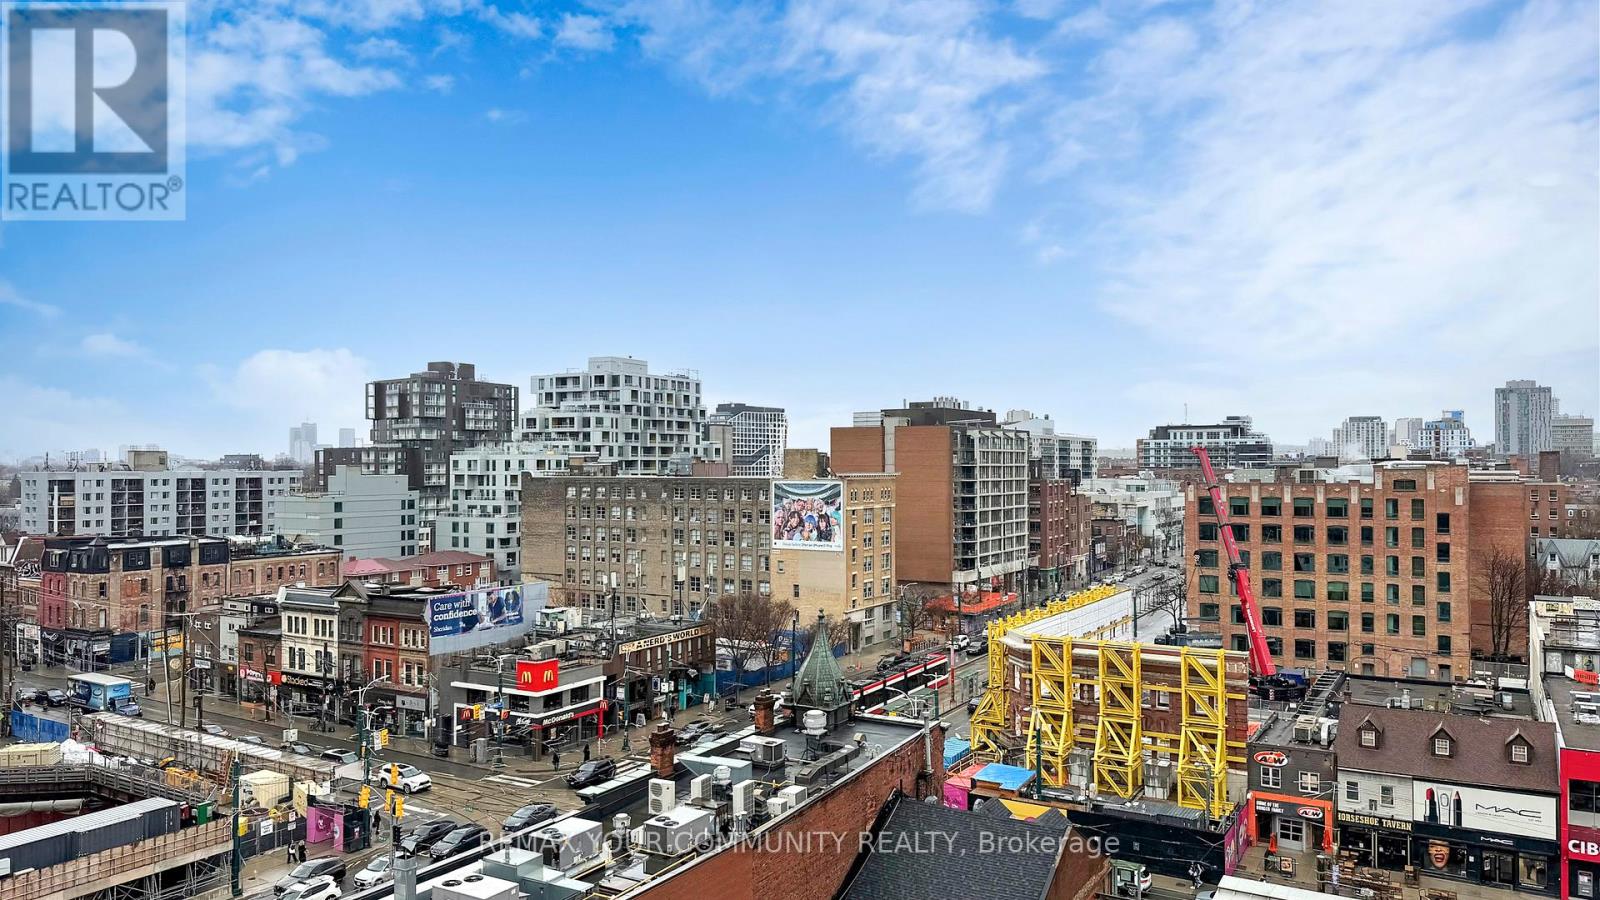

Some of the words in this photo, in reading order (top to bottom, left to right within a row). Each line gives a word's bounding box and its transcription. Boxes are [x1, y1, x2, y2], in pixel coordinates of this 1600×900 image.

[433, 602, 453, 612] Care
[453, 599, 471, 609] with
[433, 608, 477, 621] confidence
[673, 628, 699, 641] WORLD
[542, 711, 575, 726] McDonald's
[1382, 818, 1412, 831] TAVERN
[1568, 839, 1600, 856] CIB
